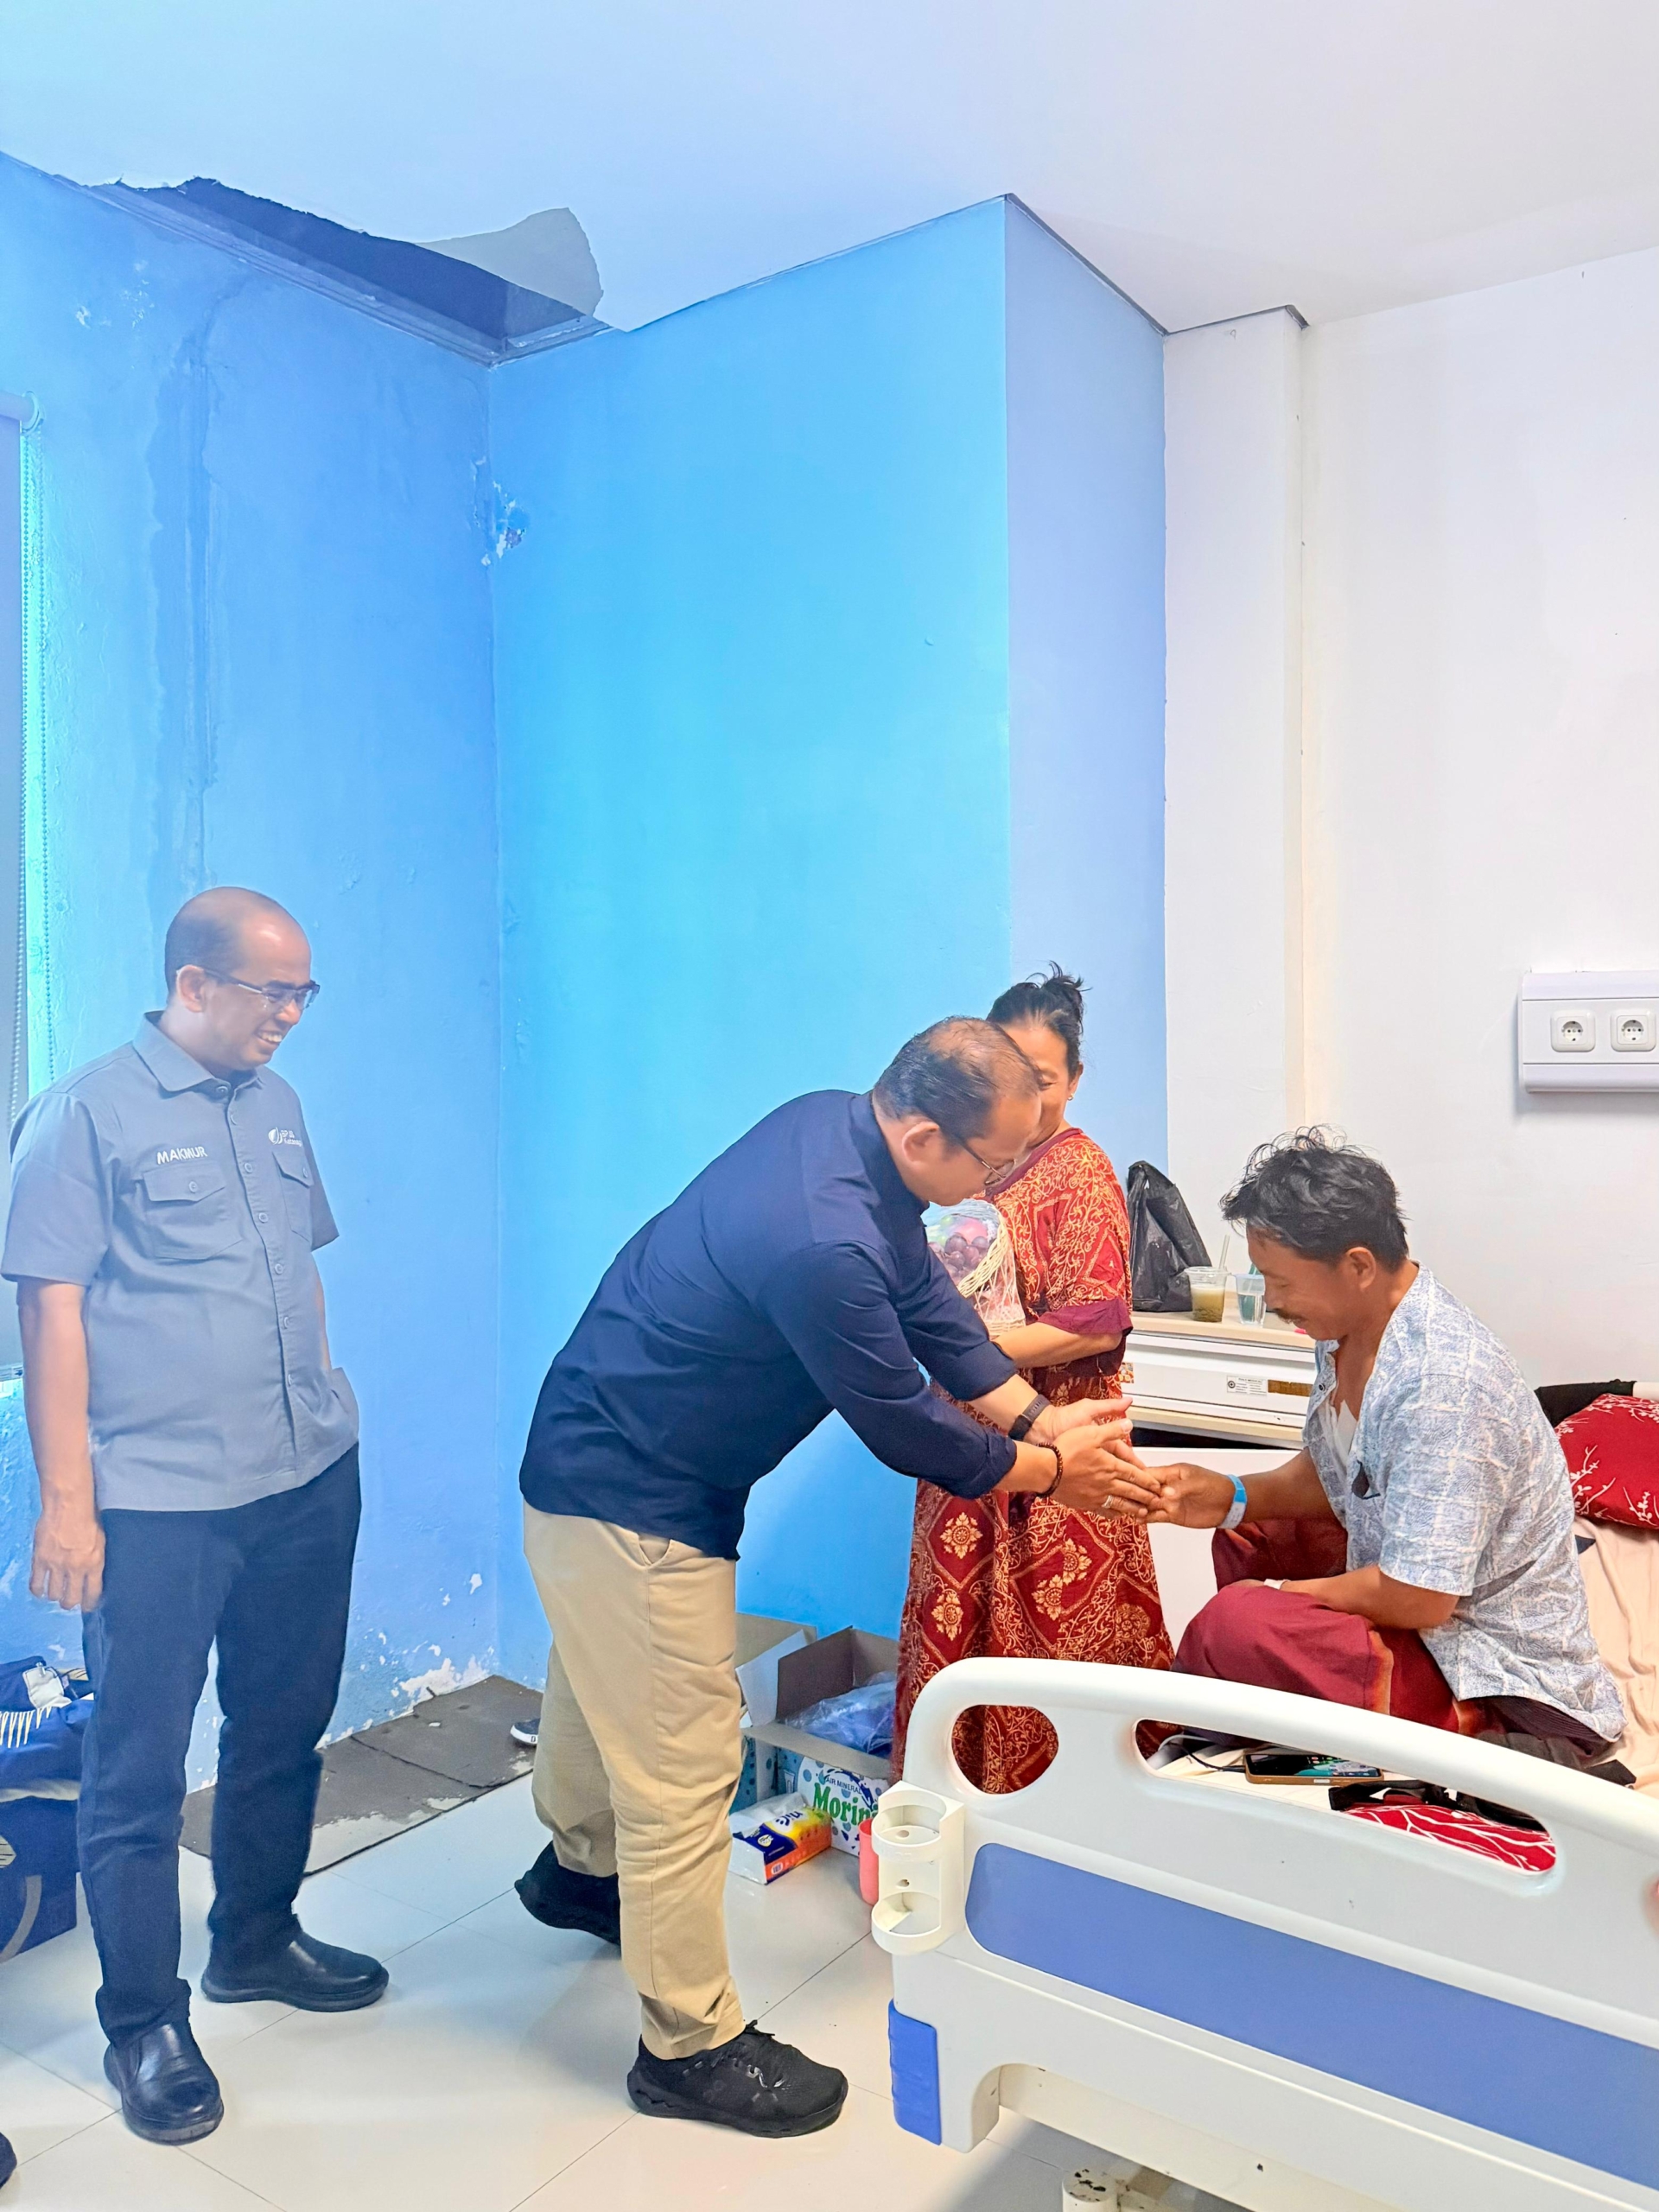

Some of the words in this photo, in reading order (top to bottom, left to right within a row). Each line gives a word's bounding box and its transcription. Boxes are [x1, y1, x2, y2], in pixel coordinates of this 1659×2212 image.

[156, 1146, 208, 1165] MAKMUR
[825, 1777, 836, 1786] AIR
[836, 1780, 862, 1796] MINERAL
